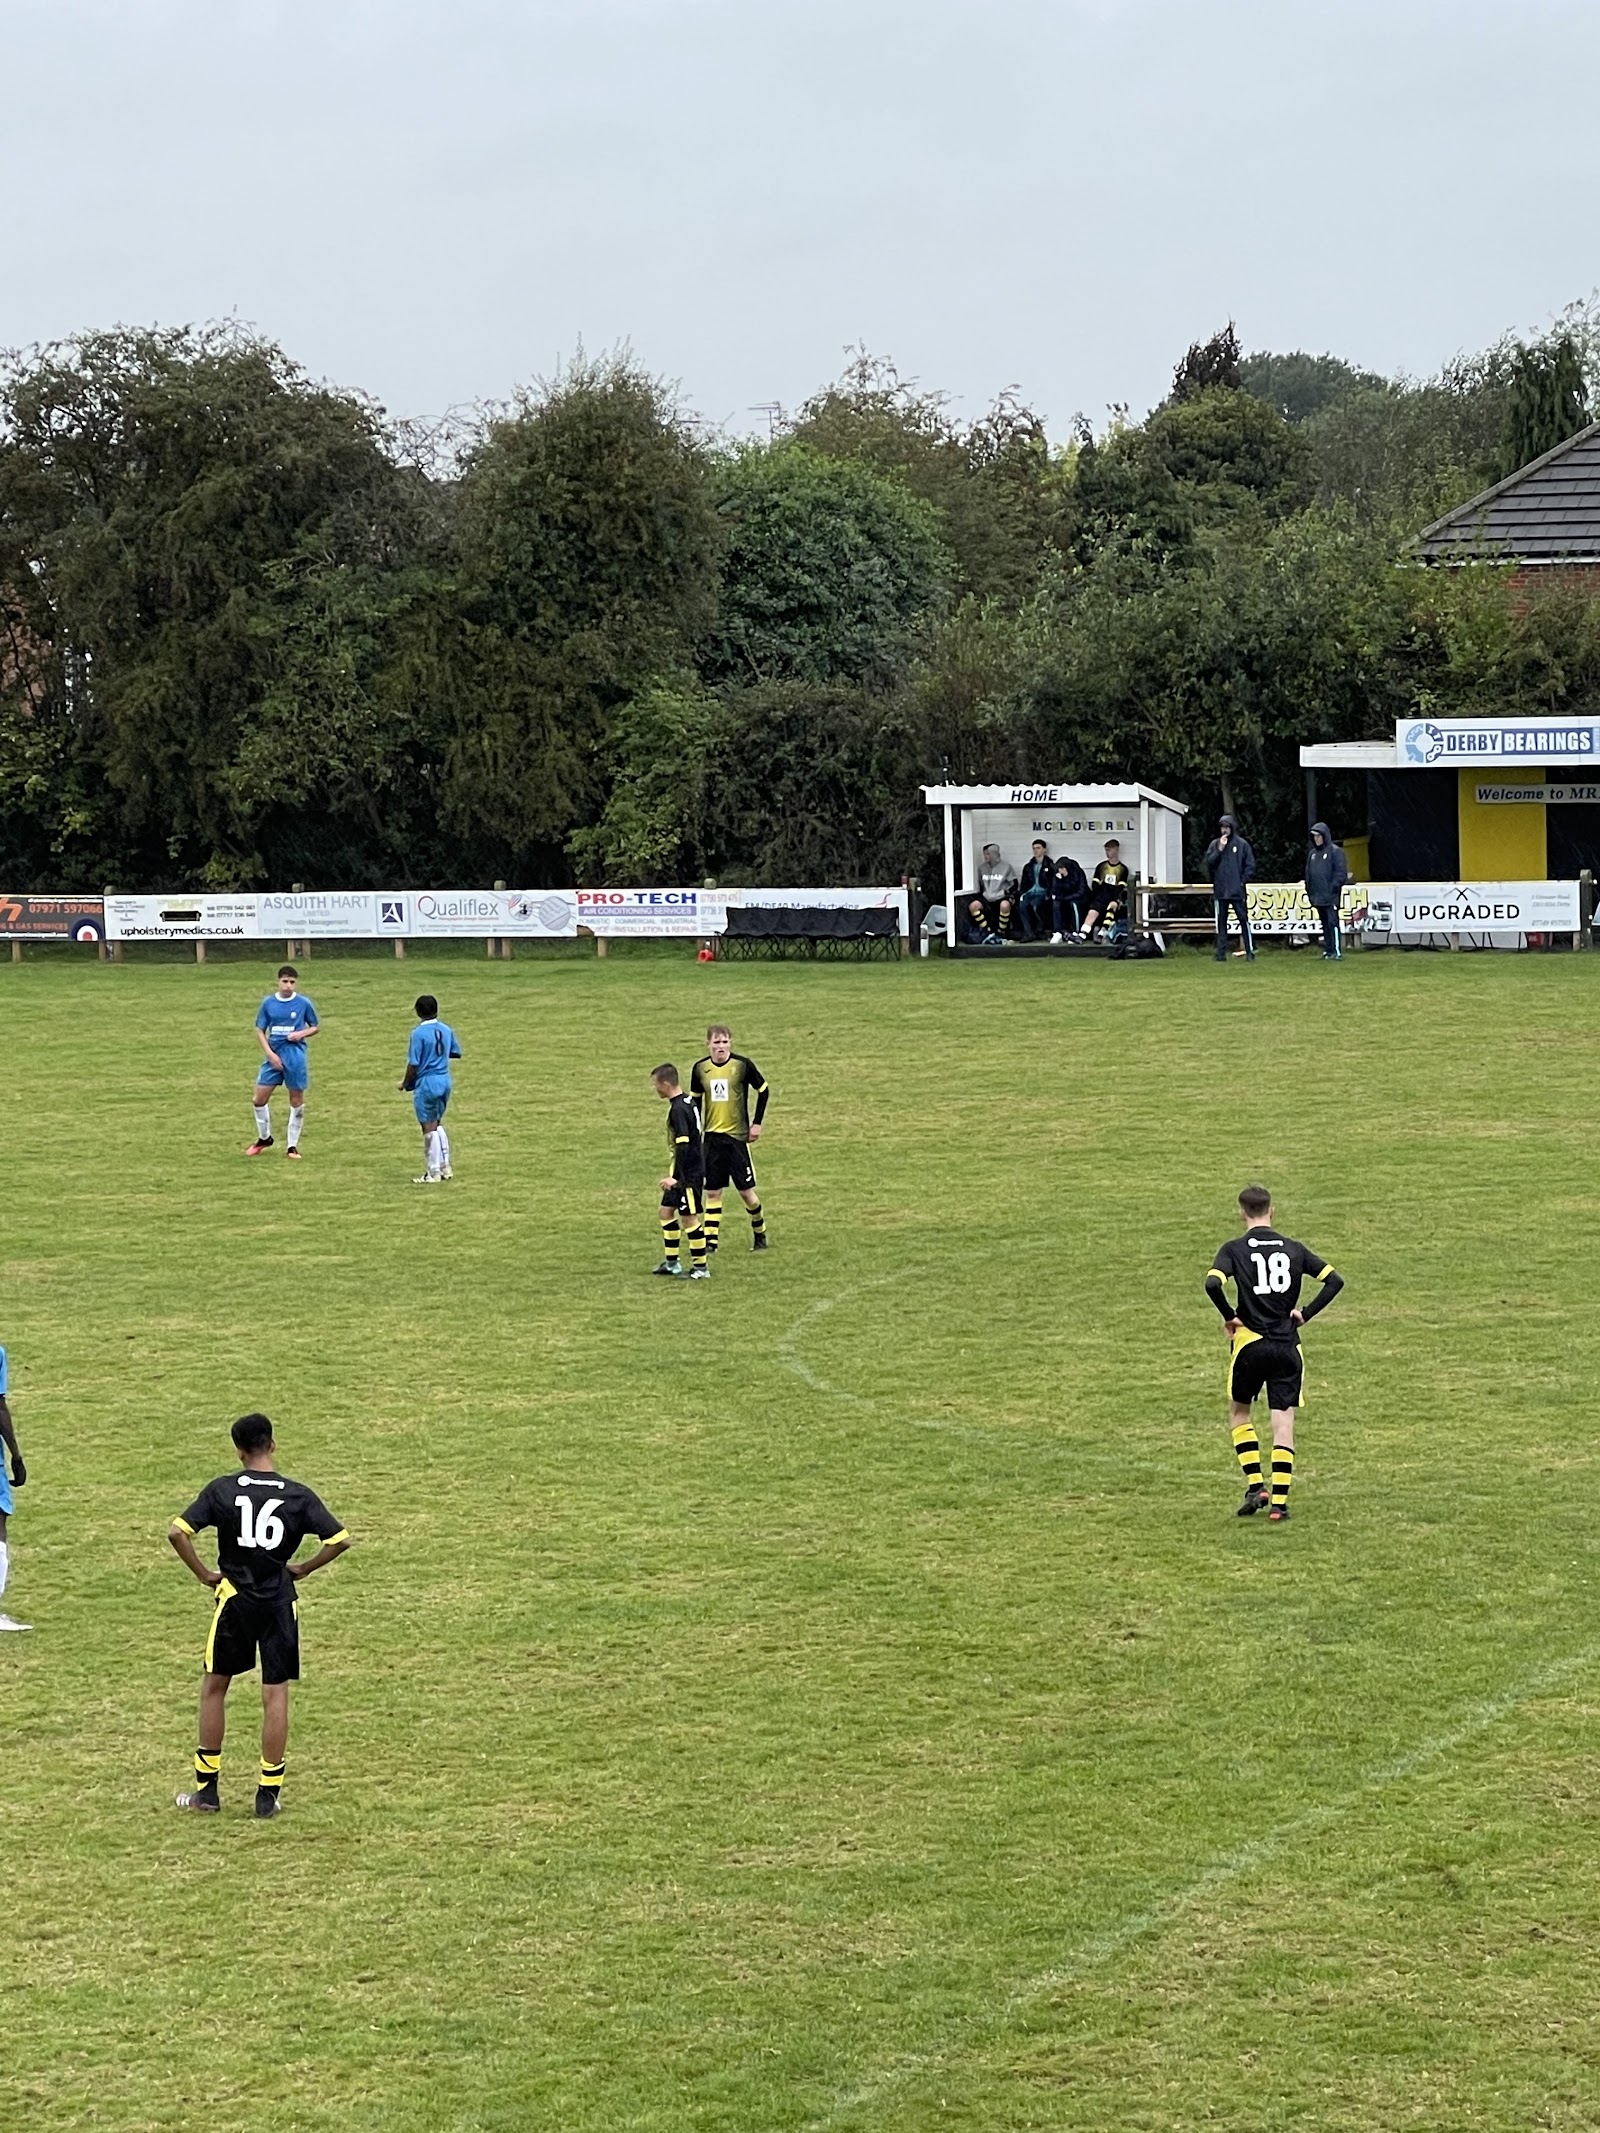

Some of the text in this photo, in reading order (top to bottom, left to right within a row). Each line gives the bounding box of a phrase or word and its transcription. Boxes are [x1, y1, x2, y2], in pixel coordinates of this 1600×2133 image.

[1447, 734, 1499, 751] DERBY
[1503, 732, 1591, 752] BEARINGS
[1011, 789, 1058, 801] HOME
[1478, 788, 1544, 800] Welcome
[1550, 789, 1564, 800] to
[263, 896, 370, 909] ASQUITH HART
[578, 893, 697, 904] PRO-TECH
[29, 904, 60, 913] 07971
[63, 904, 103, 914] 597066
[417, 896, 499, 919] Qualiflex
[583, 907, 597, 915] AIR
[598, 907, 653, 915] CONDITIONING
[1404, 904, 1520, 920] UPGRADED
[16, 922, 32, 930] GAS
[33, 922, 69, 931] SERVICES
[308, 919, 349, 927] Management
[614, 925, 664, 933] INSTALLATION
[120, 926, 244, 937] upholsterymedics.co.uk
[434, 1029, 445, 1058] 8
[1250, 1252, 1292, 1295] 18
[234, 1495, 285, 1551] 16
